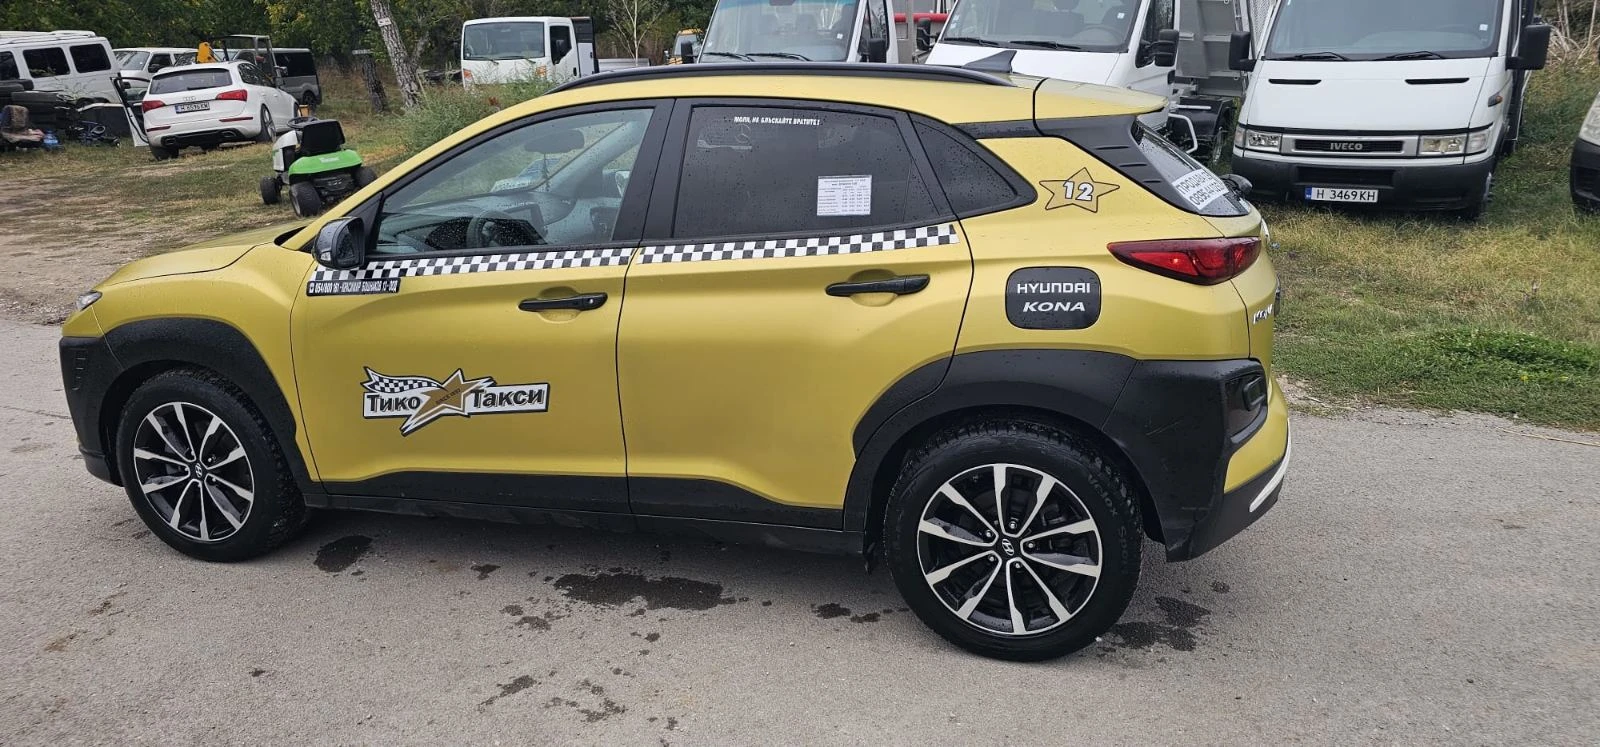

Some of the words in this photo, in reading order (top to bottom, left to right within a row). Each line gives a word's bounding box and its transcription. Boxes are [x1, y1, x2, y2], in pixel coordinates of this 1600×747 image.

[1329, 142, 1363, 151] IVECO
[1063, 181, 1094, 201] 12
[1016, 282, 1091, 294] HYUNDAI
[1022, 301, 1085, 312] KONA
[367, 394, 421, 412] Тико
[470, 388, 546, 409] Такси
